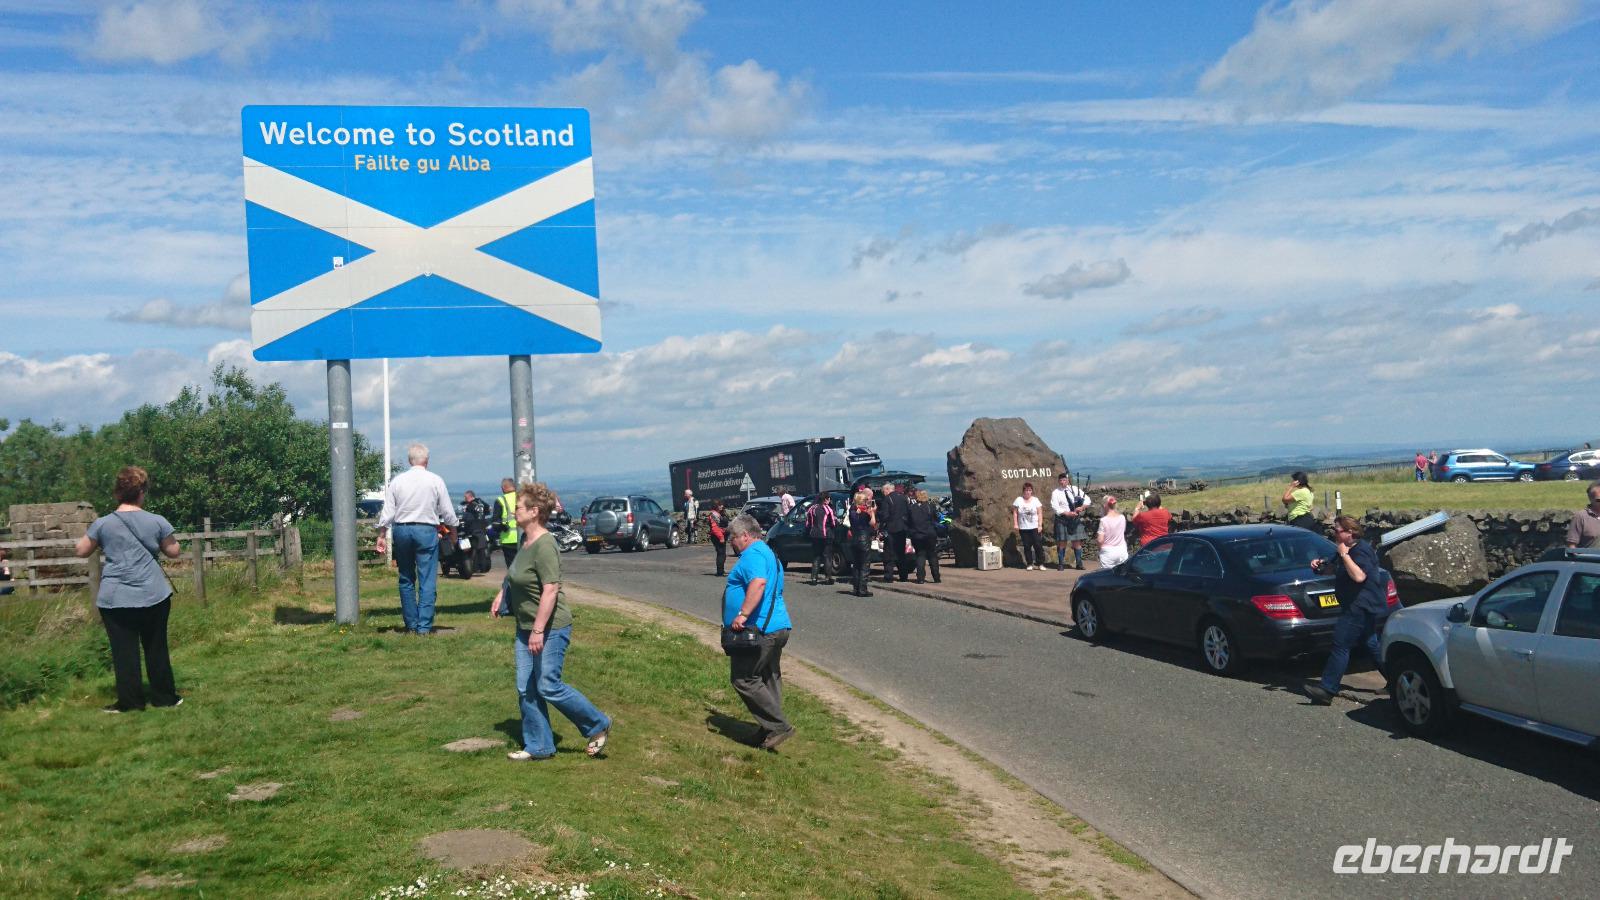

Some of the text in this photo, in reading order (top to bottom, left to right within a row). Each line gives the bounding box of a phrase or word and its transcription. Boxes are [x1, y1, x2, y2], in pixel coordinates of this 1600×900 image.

[260, 122, 574, 147] Welcome to Scotland
[354, 154, 491, 174] Fàilte gu Alba
[698, 464, 744, 478] Another successful
[1001, 467, 1052, 479] SCOTLAND
